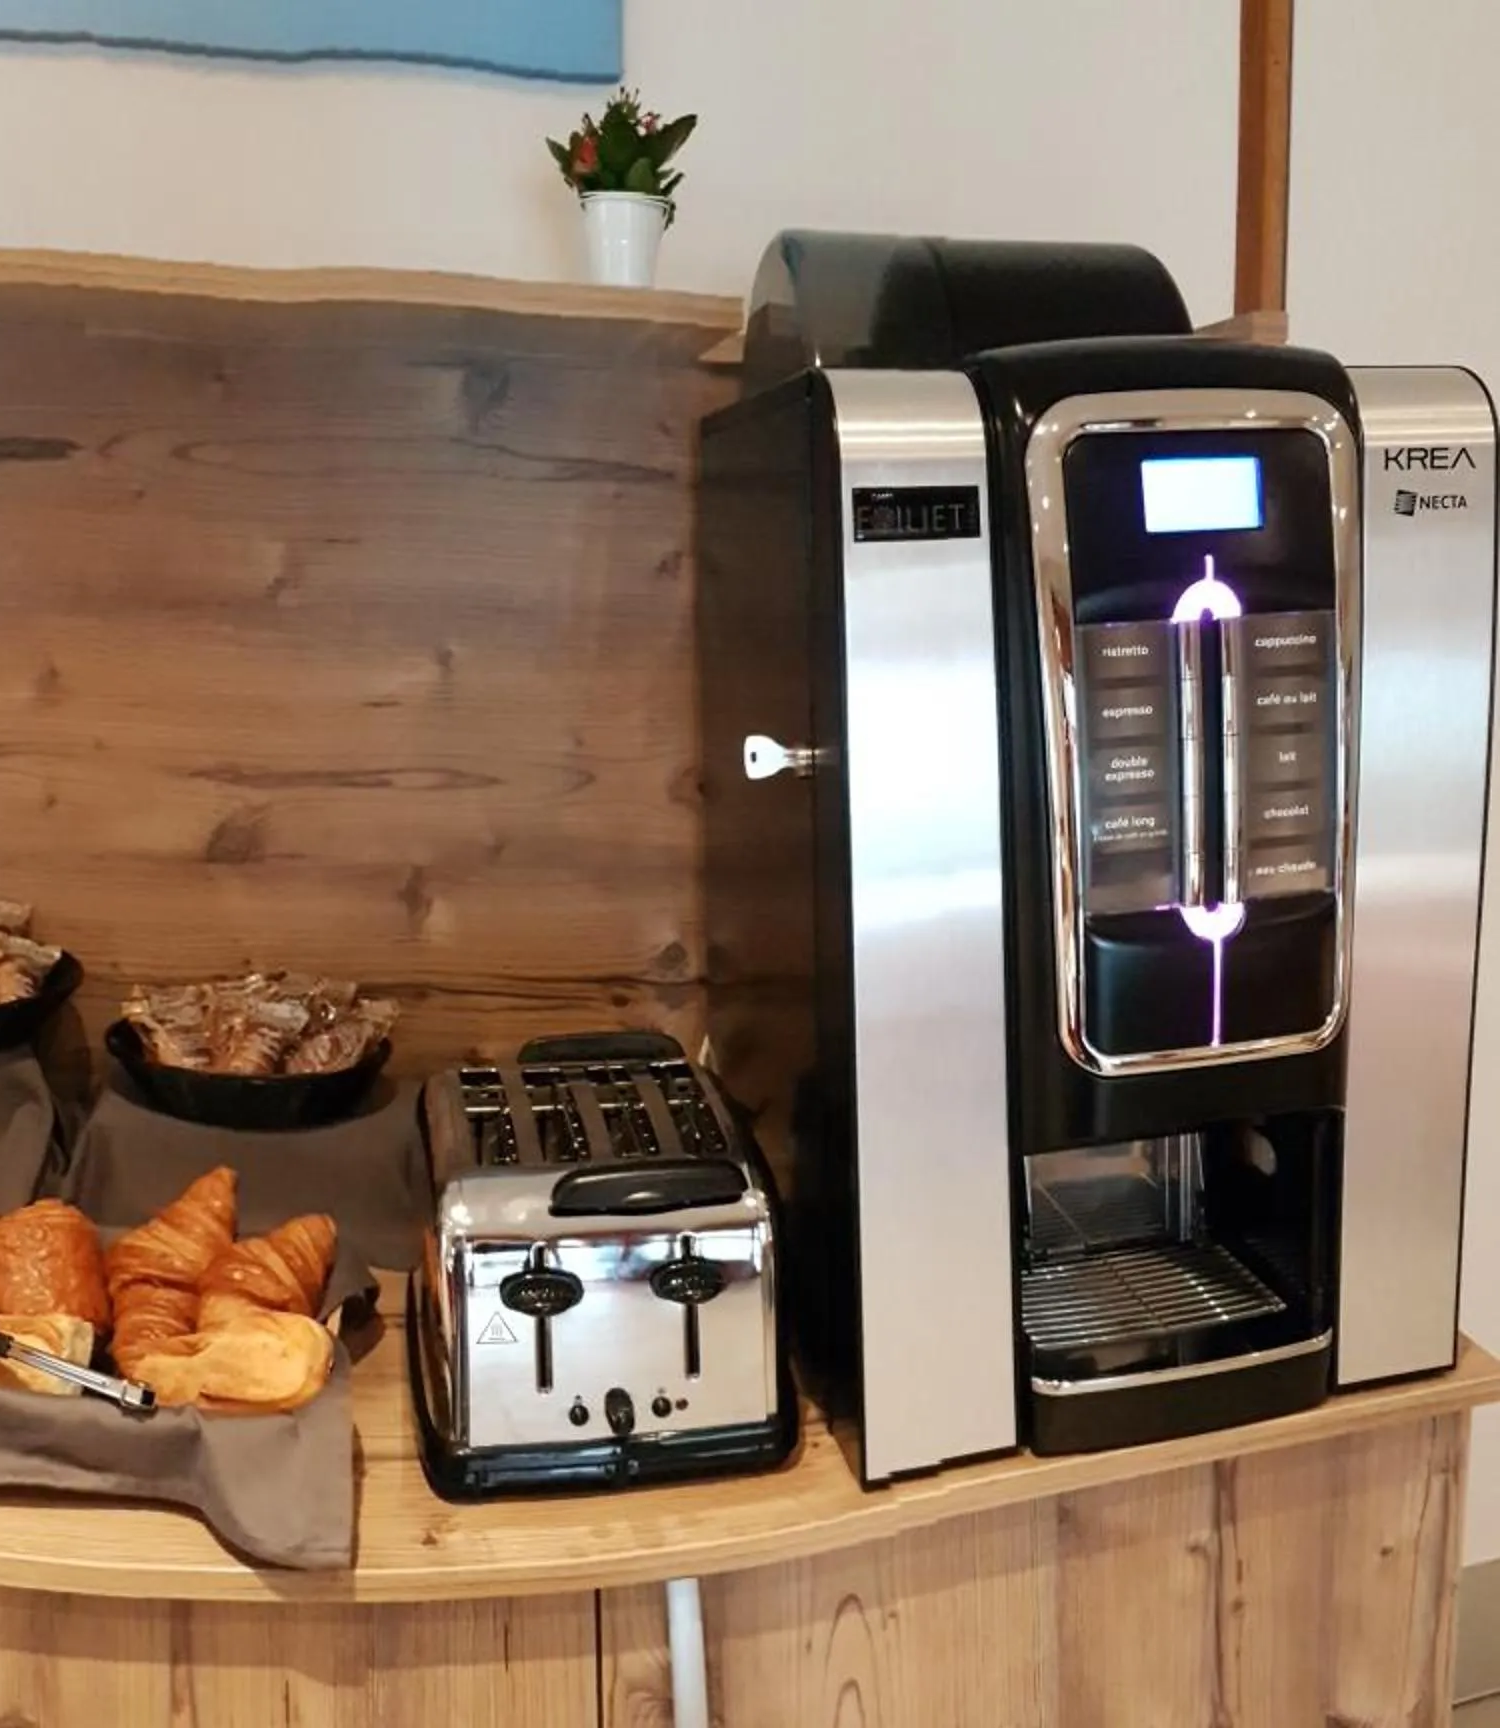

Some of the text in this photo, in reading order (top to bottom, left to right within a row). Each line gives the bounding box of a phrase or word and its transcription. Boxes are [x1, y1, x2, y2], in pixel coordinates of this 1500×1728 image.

[1383, 446, 1477, 471] KREA
[1419, 494, 1468, 510] NECTA
[1254, 634, 1317, 649] cappuccino
[1102, 644, 1150, 657] ristretto
[1257, 692, 1281, 705] café
[1299, 690, 1317, 704] lait
[1102, 705, 1153, 720] espresso
[1110, 755, 1149, 769] double
[1279, 751, 1297, 762] lait
[1104, 769, 1155, 783] espresso
[1263, 804, 1309, 819] chocolat
[1105, 815, 1156, 830] café long
